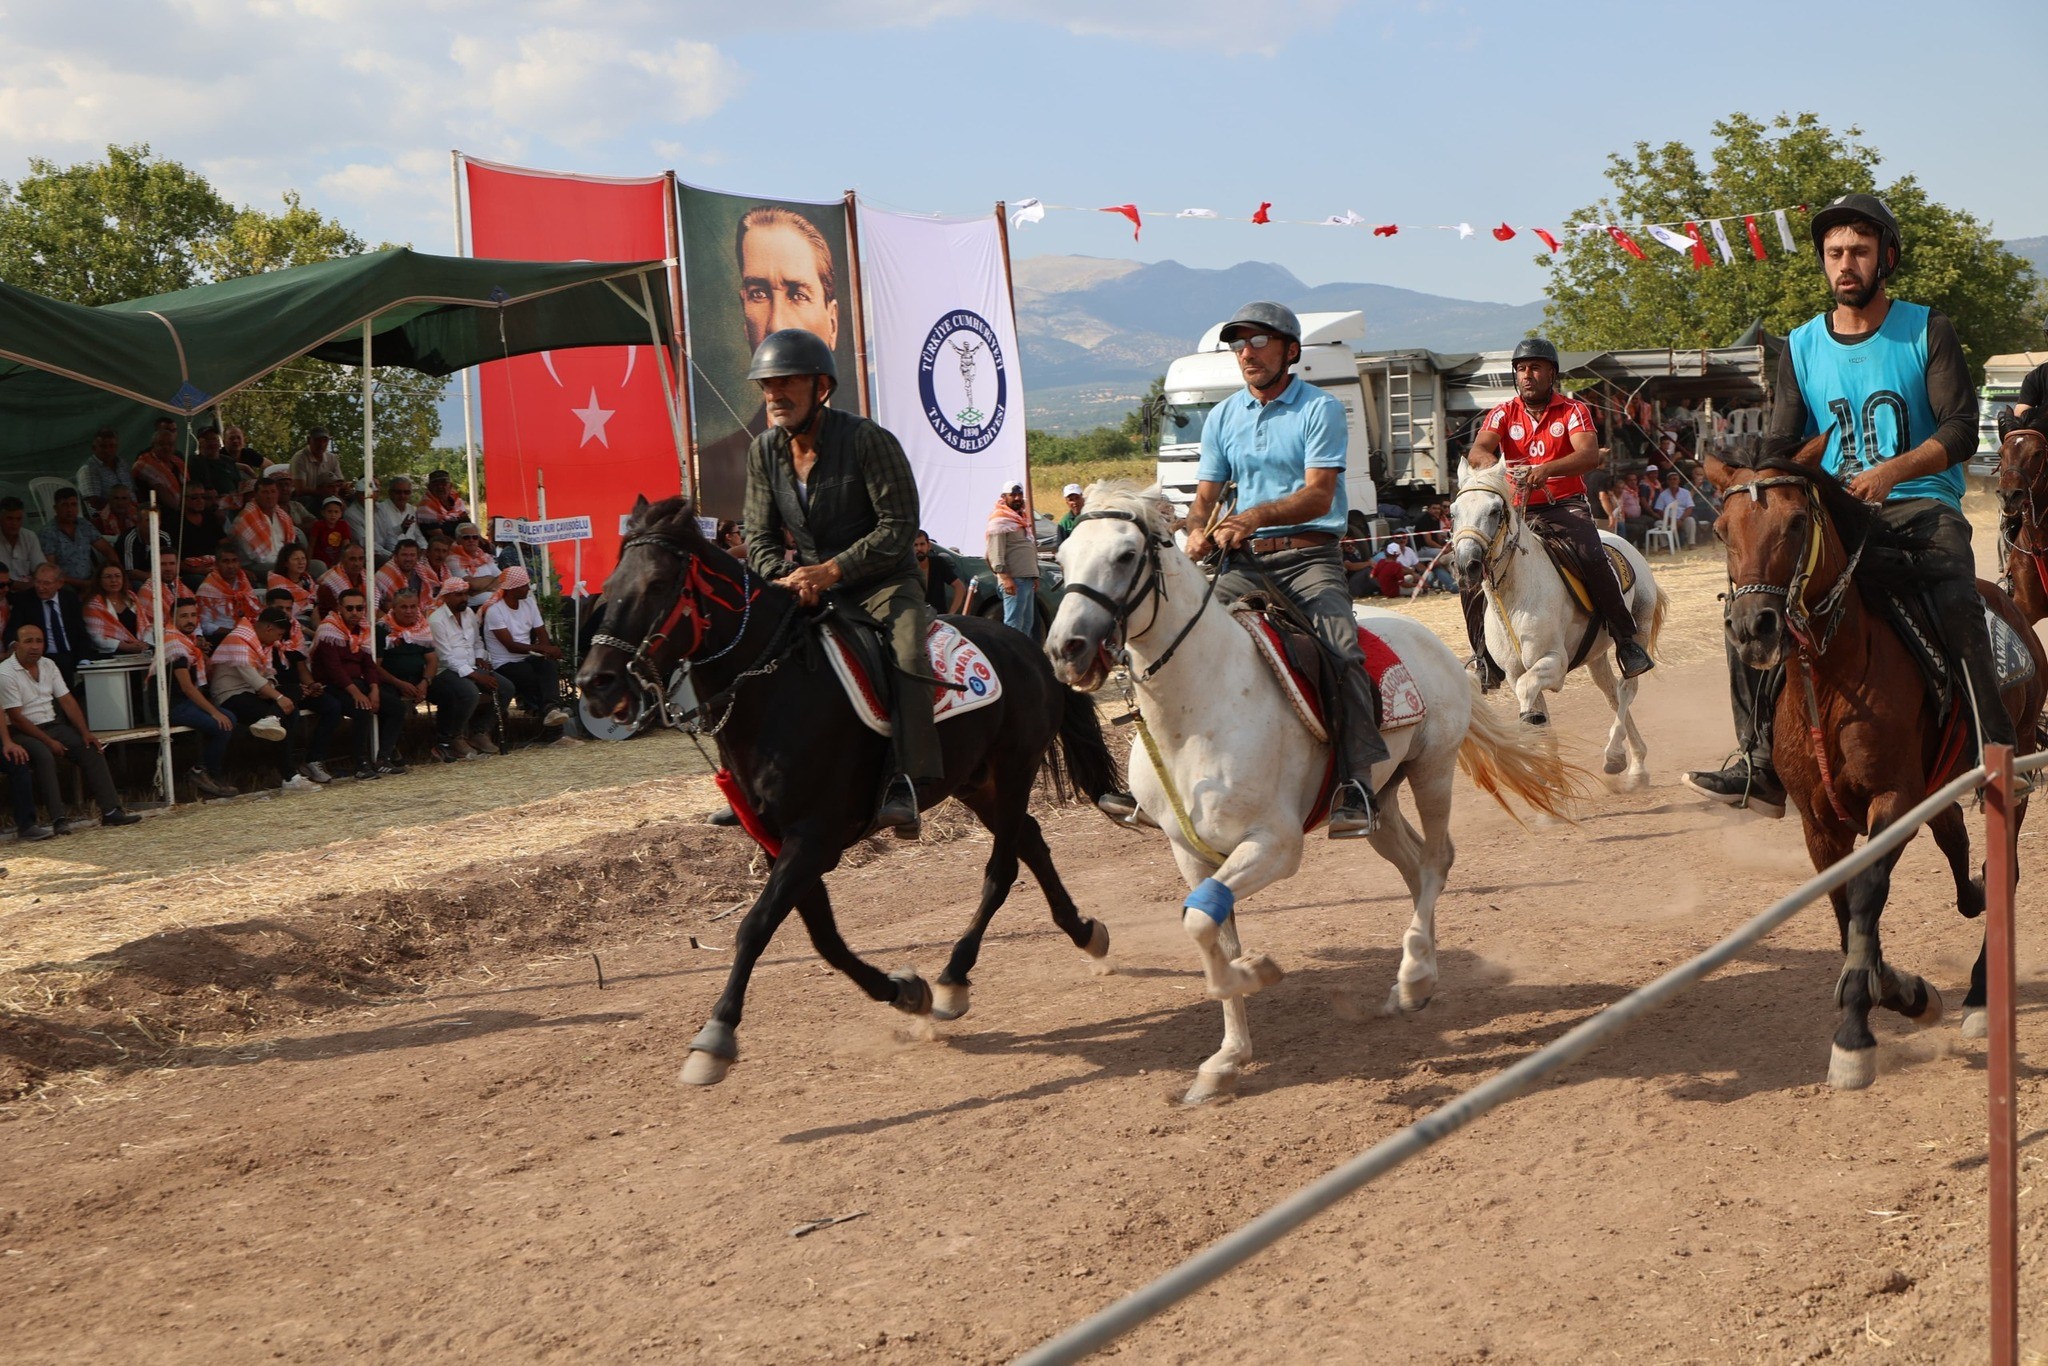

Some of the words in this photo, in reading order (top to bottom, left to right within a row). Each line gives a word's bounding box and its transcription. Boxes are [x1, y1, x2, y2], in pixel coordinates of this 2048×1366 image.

[922, 318, 953, 372] TÜRKİYE
[952, 314, 1004, 371] CUMHURİYETİ
[928, 406, 959, 446] TAVAS
[959, 404, 1005, 451] BELEDİYESİ
[963, 428, 979, 438] 1890
[1828, 390, 1911, 475] 10
[1529, 440, 1545, 457] 60
[518, 523, 542, 535] BÜLENT
